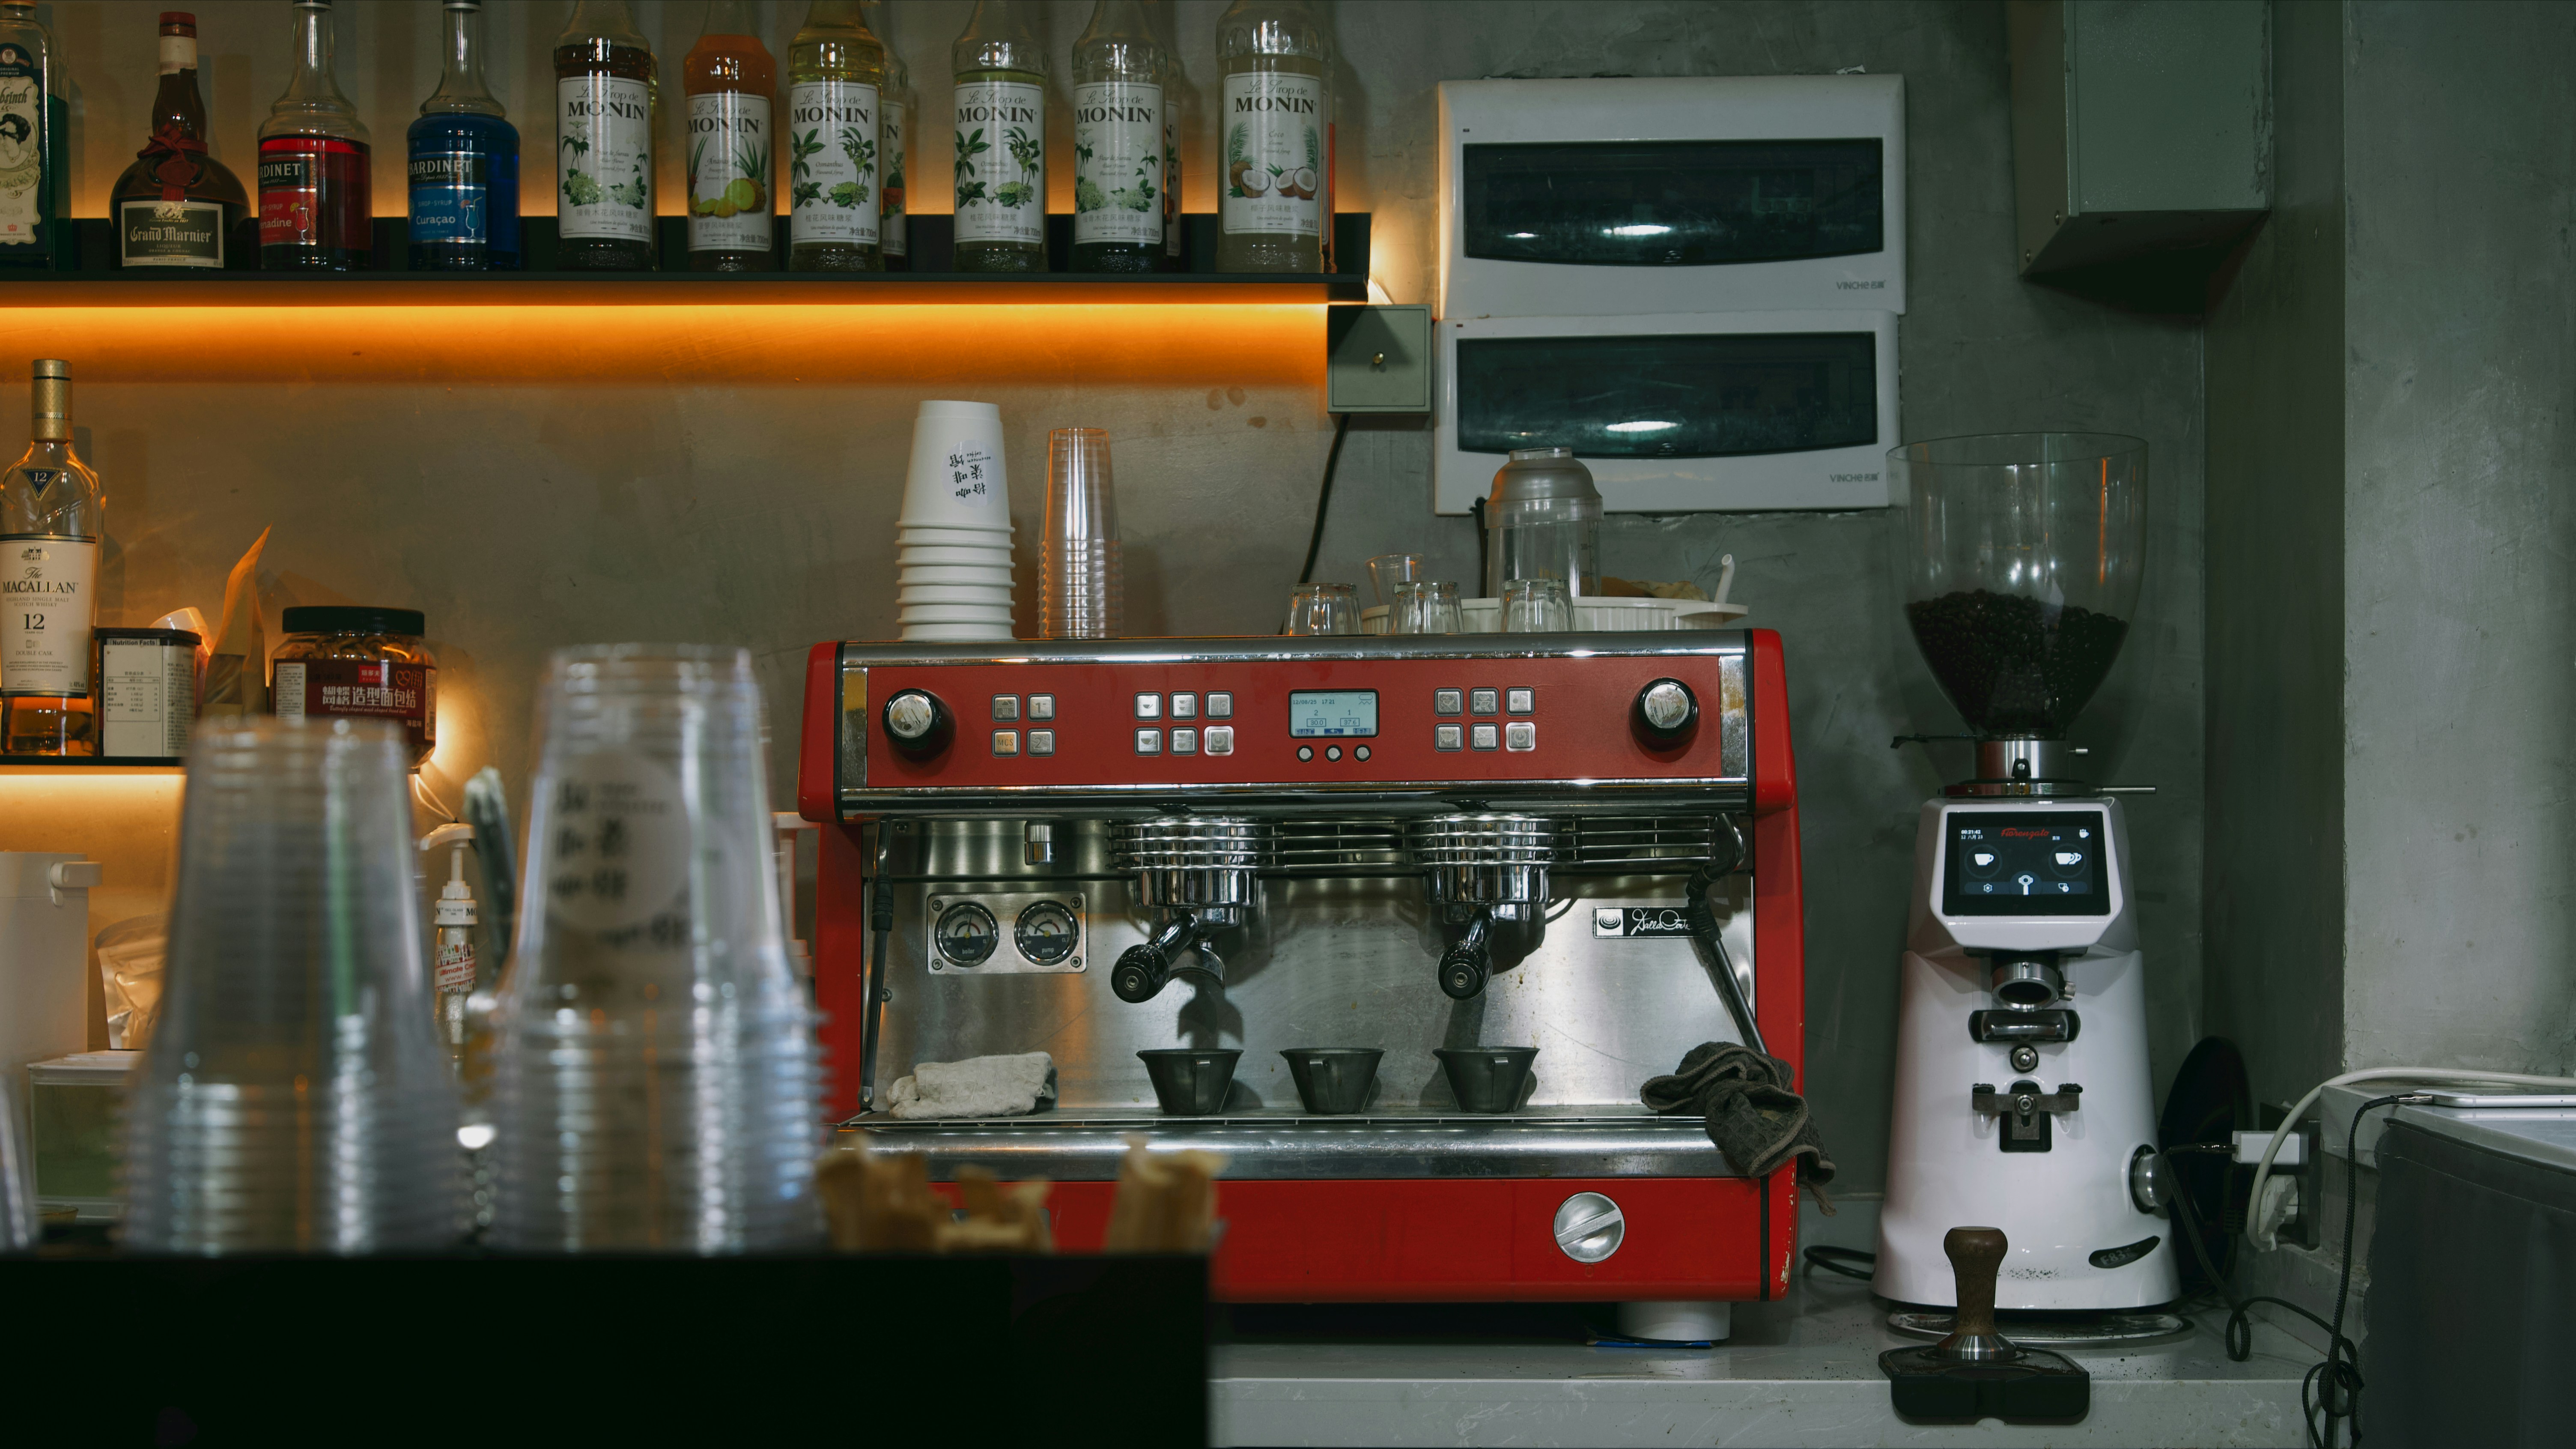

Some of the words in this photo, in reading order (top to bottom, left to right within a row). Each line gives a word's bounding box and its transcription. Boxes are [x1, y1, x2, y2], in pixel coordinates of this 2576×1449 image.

[596, 84, 626, 103] Srop
[629, 93, 639, 101] de
[1244, 80, 1262, 94] Le
[1265, 79, 1294, 97] Sirop
[1297, 87, 1308, 95] de
[799, 90, 814, 105] Le
[850, 96, 861, 105] de
[965, 90, 979, 104] Le
[1014, 96, 1026, 105] de
[1083, 90, 1097, 105] Le
[1131, 96, 1144, 104] de
[567, 101, 645, 121] MONIN
[692, 102, 705, 116] Le
[739, 106, 751, 115] de
[1235, 96, 1315, 115] MONIN
[794, 107, 869, 124] MONIN
[958, 106, 1034, 123] MONIN
[1077, 107, 1152, 125] MONIN
[688, 117, 760, 134] MONIN
[1269, 129, 1284, 137] Coco
[409, 160, 472, 175] BARDINET
[416, 216, 456, 226] Curaçao
[130, 226, 161, 242] Grand
[163, 226, 212, 243] Marnier
[33, 472, 47, 482] 12
[23, 566, 42, 580] The
[2, 580, 76, 594] MACALLAN
[24, 613, 45, 630] 12
[322, 686, 350, 695] 蝴蝶
[352, 687, 416, 709] 造型面包结
[322, 696, 350, 705] 网格
[1035, 702, 1041, 713] 1
[1034, 737, 1042, 749] 2
[2001, 828, 2049, 840] Fiorenzato
[1631, 908, 1662, 936] Dalla
[439, 966, 463, 976] Ultimate
